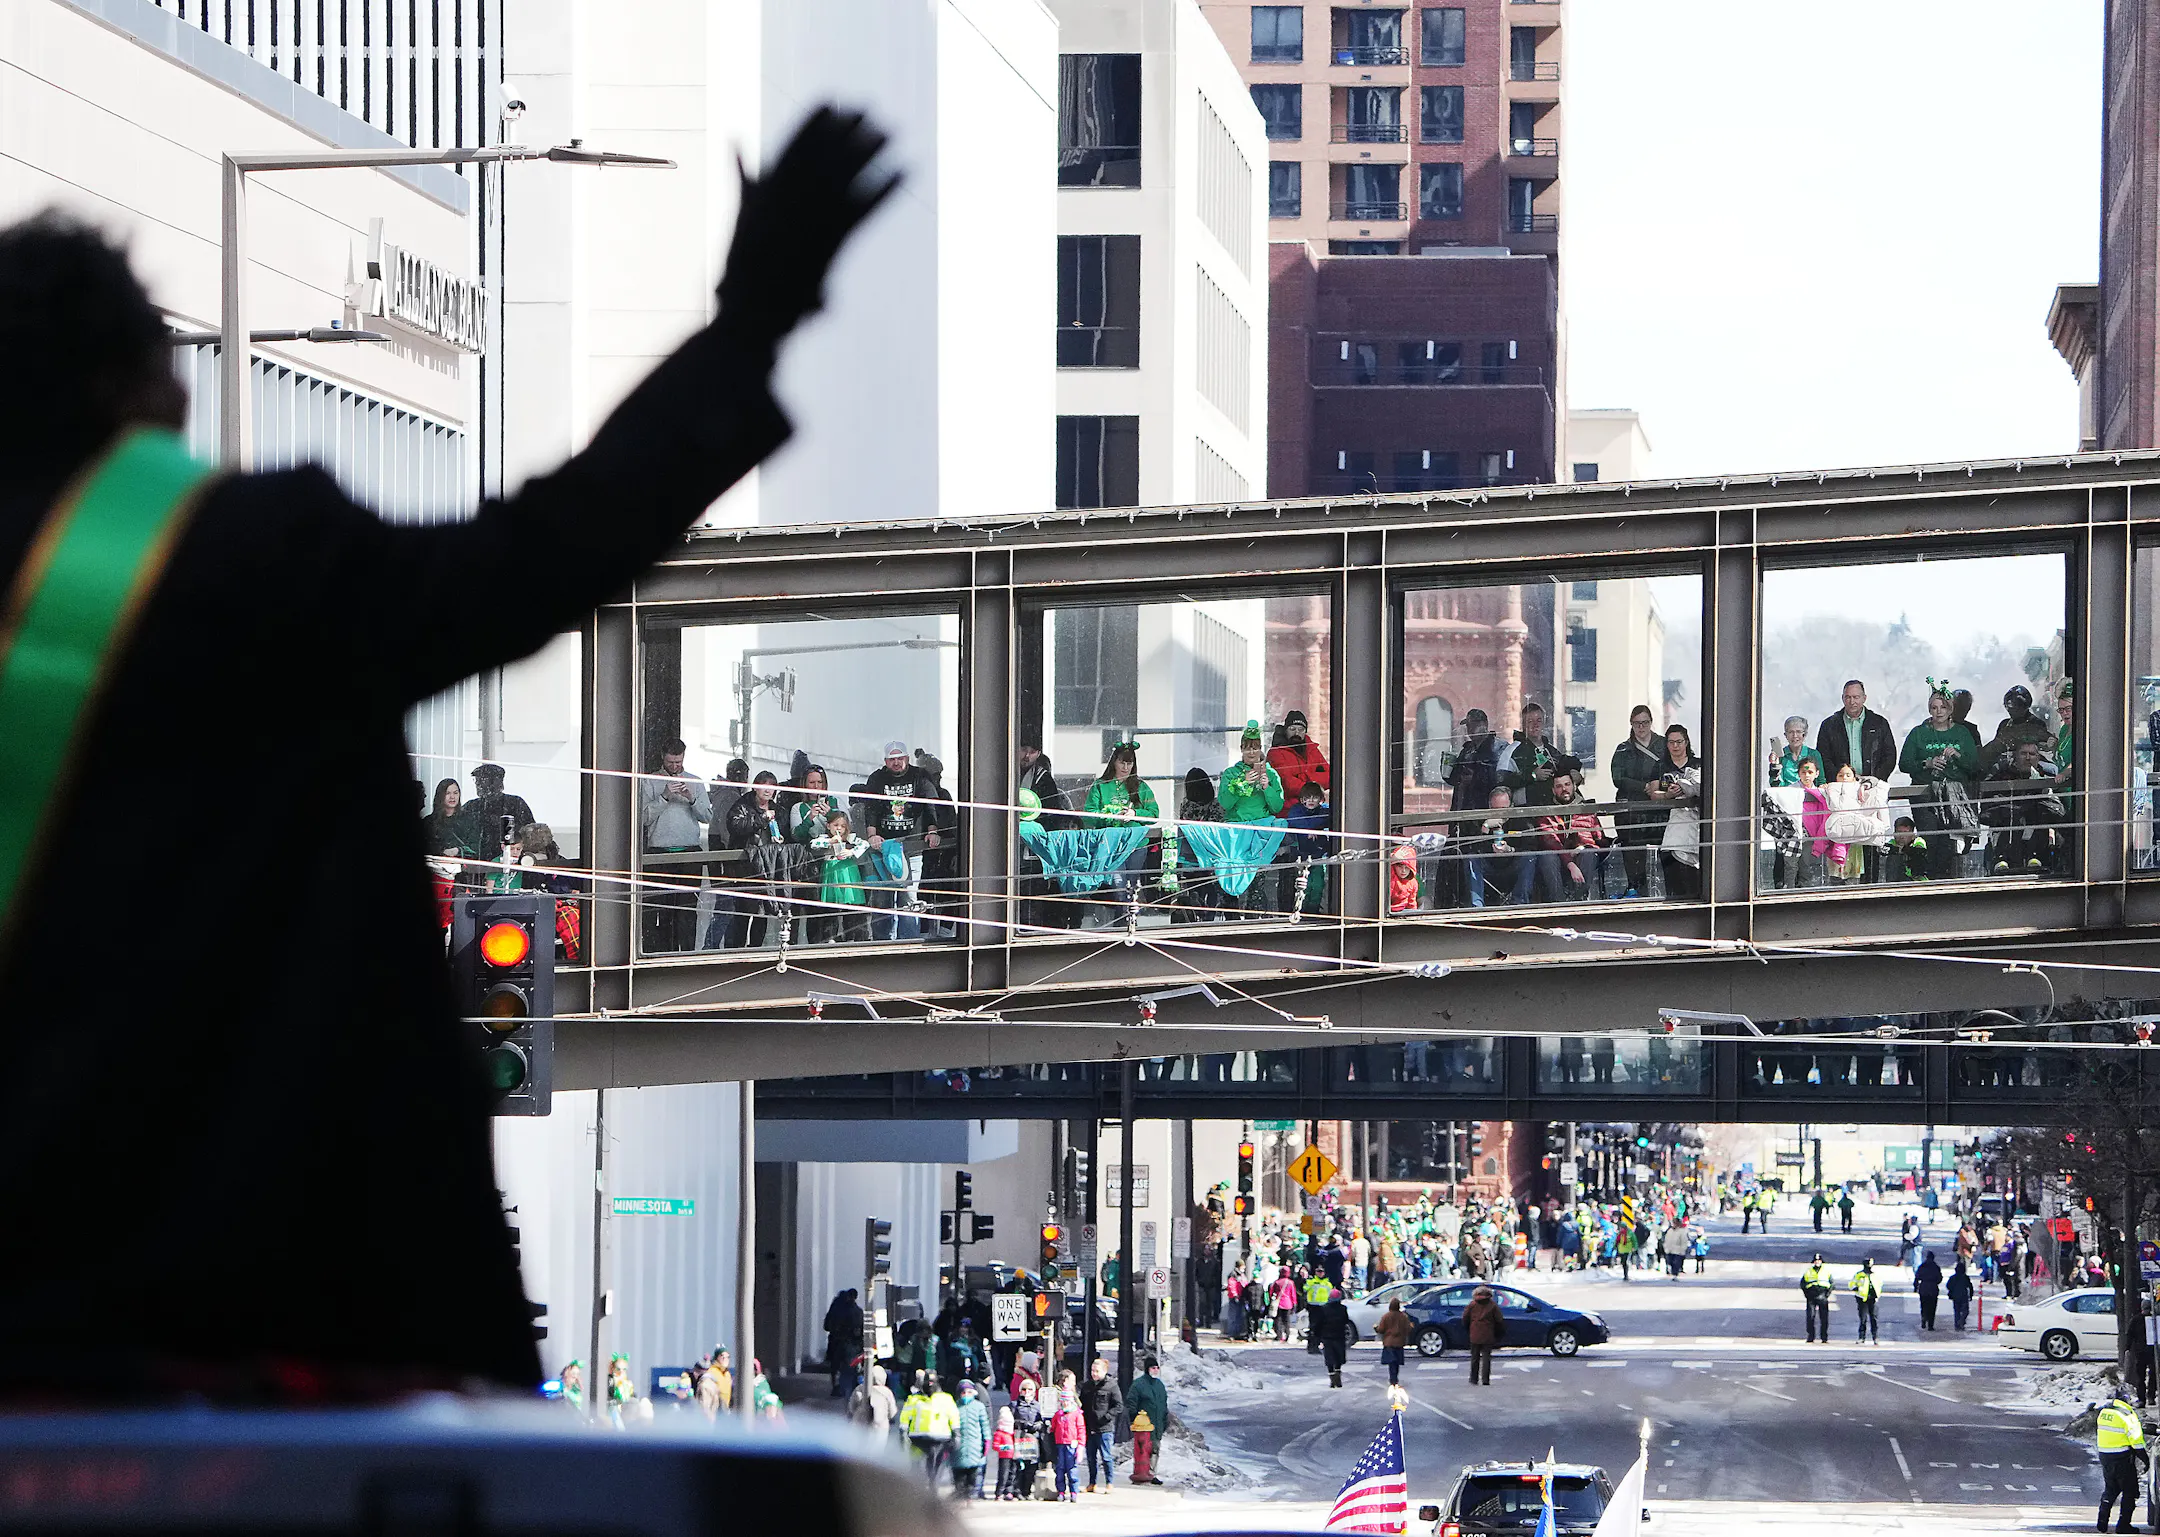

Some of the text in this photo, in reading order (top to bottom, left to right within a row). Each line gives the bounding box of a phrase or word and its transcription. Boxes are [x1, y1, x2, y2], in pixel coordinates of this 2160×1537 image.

[394, 245, 491, 355] ALLIANCE BANK
[614, 1200, 672, 1212] MINNESOTA
[997, 1299, 1021, 1309] ONE
[997, 1311, 1021, 1322] WAY
[2100, 1412, 2114, 1422] POLICE
[1929, 1462, 2081, 1471] ONLY
[1959, 1483, 2082, 1493] BUS
